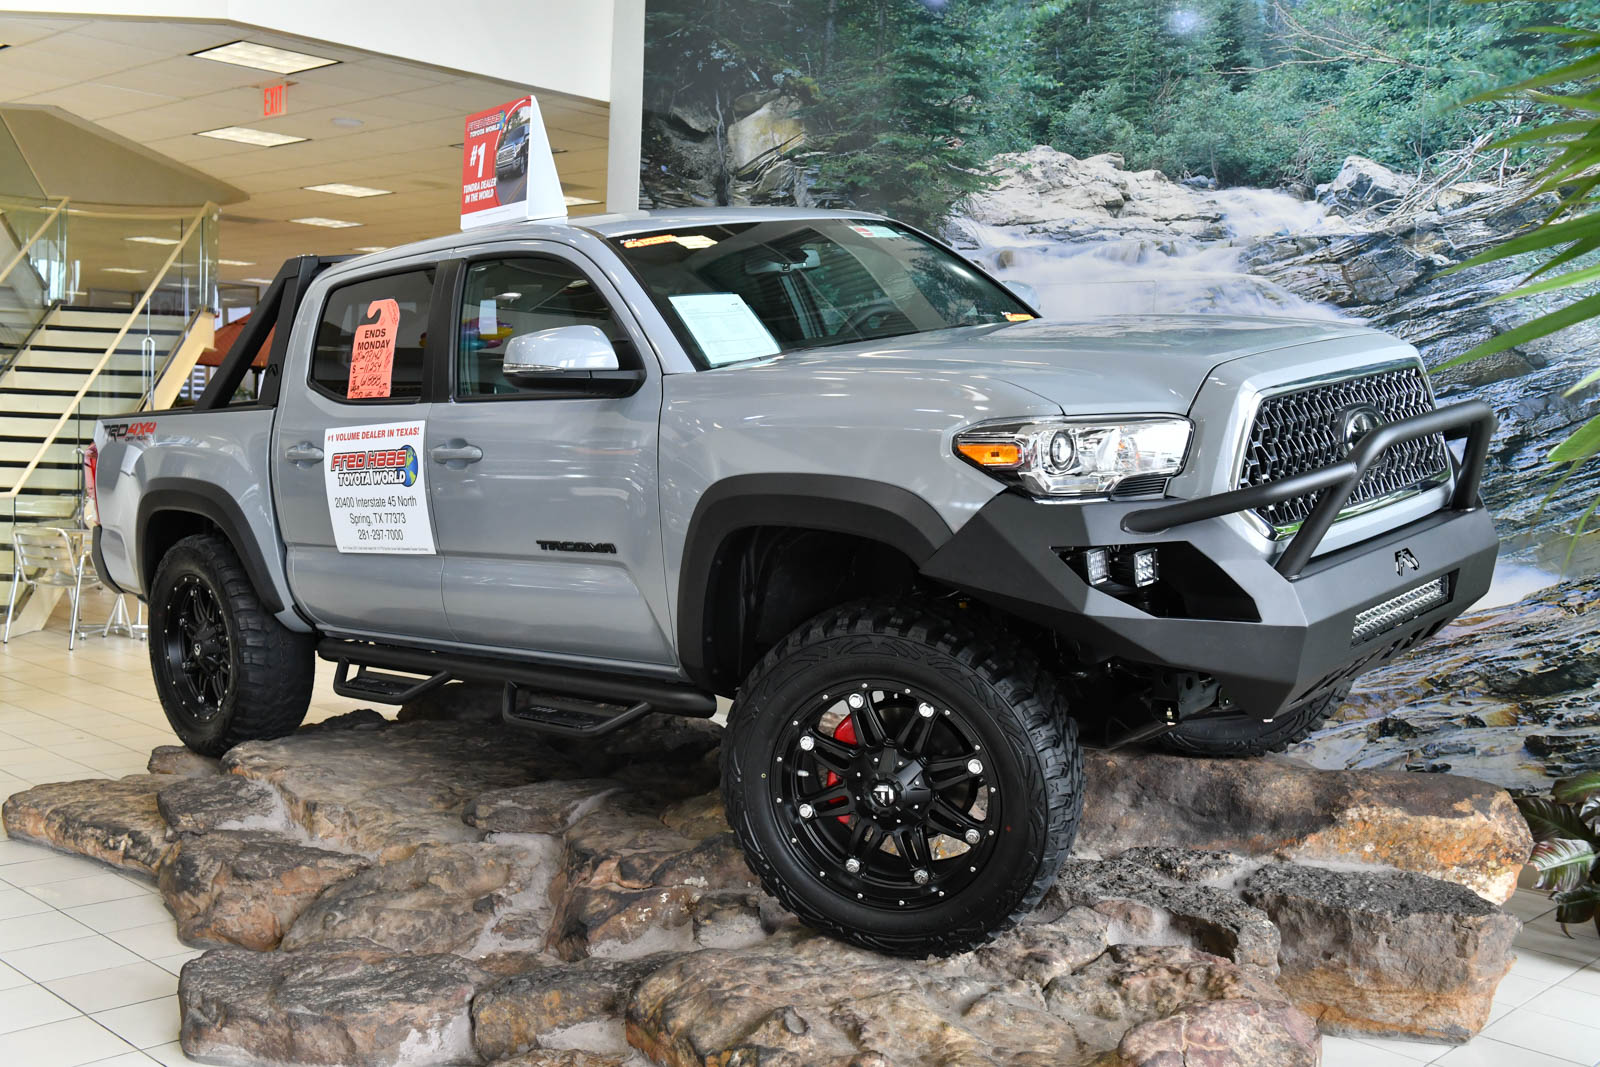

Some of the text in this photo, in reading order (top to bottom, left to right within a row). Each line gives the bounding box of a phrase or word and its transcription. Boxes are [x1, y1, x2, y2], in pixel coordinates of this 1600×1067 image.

[264, 84, 283, 116] EXIT
[470, 123, 500, 138] TOYOTA WORLD
[469, 142, 486, 178] #1
[463, 177, 497, 194] TUNDRA DEALER
[465, 188, 495, 204] IN THE WORLD
[364, 328, 386, 339] ENDS
[357, 339, 391, 350] MONDAY
[328, 427, 420, 442] #1 VOLUME DEALER IN TEXAS!
[338, 469, 406, 487] TOYOTA WORLD
[335, 495, 417, 508] 20400 Interstate 45 North
[349, 512, 406, 527] Spring, TX 77373
[357, 529, 404, 541] 281-297-7000
[536, 540, 617, 554] TACOMA
